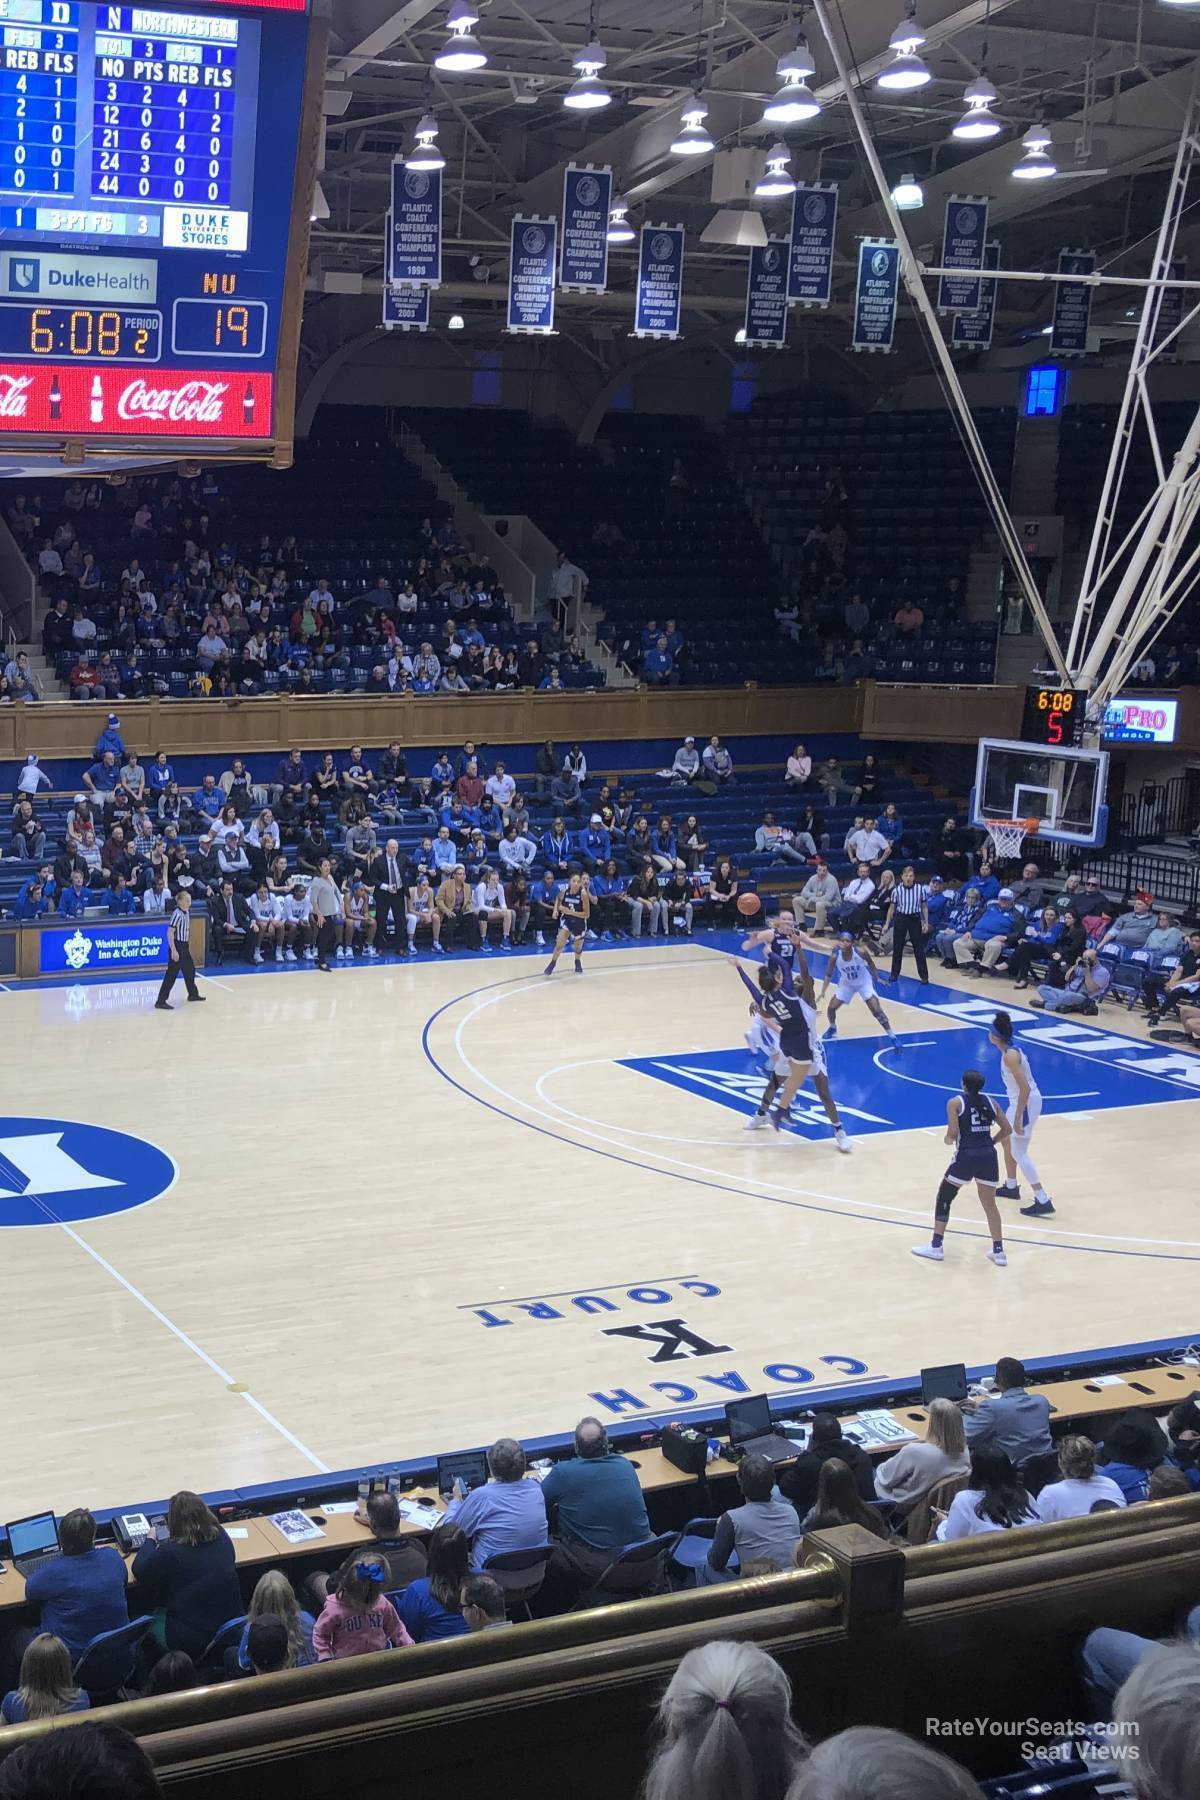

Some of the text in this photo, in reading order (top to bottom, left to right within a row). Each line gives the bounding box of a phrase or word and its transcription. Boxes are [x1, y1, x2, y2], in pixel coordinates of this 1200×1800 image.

[108, 7, 121, 30] N
[132, 9, 238, 40] NORTHWESTERN
[13, 31, 35, 47] FLS
[55, 34, 64, 49] 3
[6, 49, 38, 70] REB
[44, 52, 74, 74] FLS
[145, 42, 222, 64] 3 1
[102, 58, 233, 87] NO PTS REB FLS
[16, 74, 27, 94] 4
[55, 78, 62, 97] 1
[107, 82, 220, 110] 3 2 4 1
[16, 98, 26, 117] 2
[54, 101, 61, 120] 1
[103, 106, 221, 133] 12 0 1 2
[17, 121, 24, 141] 1
[51, 124, 63, 144] 0
[102, 129, 220, 155] 21 6 4 0
[14, 145, 26, 164] 0
[51, 148, 62, 167] 0
[100, 152, 219, 178] 24 3 0 0
[14, 169, 26, 188] 0
[52, 171, 59, 190] 1
[99, 175, 218, 201] 44 0 0 0
[401, 203, 433, 213] ATLANTIC
[406, 213, 428, 223] COAST
[572, 210, 601, 220] ATLANTIC
[16, 208, 22, 227] 1
[137, 216, 148, 233] 3
[182, 213, 229, 227] DUKE
[395, 223, 439, 233] CONFERENCE
[576, 220, 596, 229] COAST
[182, 232, 229, 245] STORES
[401, 234, 433, 243] WOMEN'S
[565, 229, 606, 239] CONFERENCE
[571, 239, 601, 248] WOMEN'S
[396, 243, 436, 253] CHAMPIONS
[566, 248, 603, 258] CHAMPIONS
[519, 258, 548, 267] ATLANTIC
[523, 267, 543, 275] COAST
[48, 270, 149, 291] DukeHealth
[203, 273, 236, 294] NU
[513, 275, 552, 285] CONFERENCE
[518, 285, 547, 293] WOMEN'S
[514, 293, 549, 302] CHAMPIONS
[31, 309, 121, 355] 6:08
[124, 317, 158, 330] PERIOD
[215, 306, 248, 347] 19
[135, 329, 149, 354] 2
[117, 379, 229, 422] Coca-Cola
[1038, 692, 1073, 712] 6:08
[1046, 712, 1063, 743] 5
[95, 936, 162, 950] Washington Duke
[98, 950, 111, 959] Inn
[113, 949, 120, 958] &
[121, 948, 138, 958] Golf
[781, 945, 794, 957] 21
[769, 1000, 791, 1018] 12
[472, 1280, 722, 1329] COURT
[599, 1318, 737, 1364] K
[587, 1354, 869, 1414] COACH
